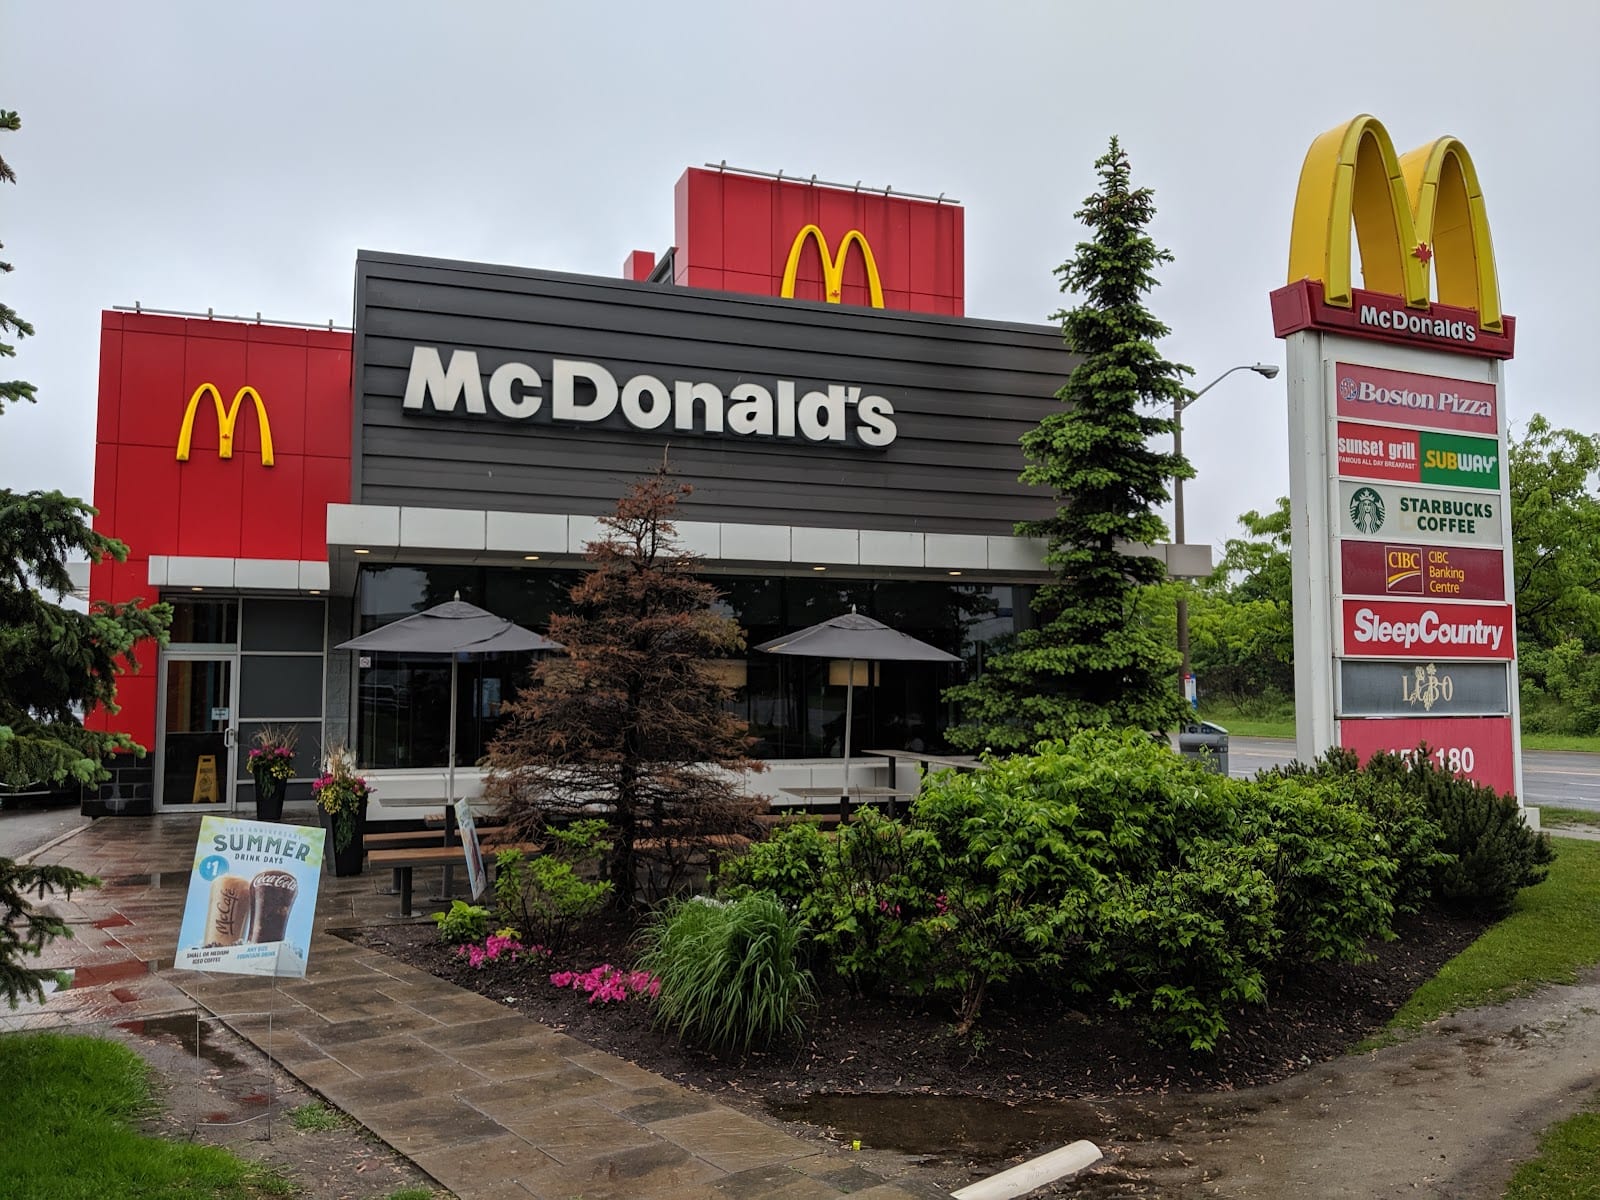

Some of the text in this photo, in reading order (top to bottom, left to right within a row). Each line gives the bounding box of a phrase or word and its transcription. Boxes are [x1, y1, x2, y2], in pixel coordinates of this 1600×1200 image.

[1360, 304, 1477, 342] McDonald's
[403, 346, 898, 447] McDonald's
[1359, 381, 1493, 417] Boston Pizza
[1338, 437, 1417, 460] sunset grill
[1338, 456, 1416, 470] FAMOUS ALL DAY BREAKFAST
[1424, 450, 1497, 474] SUBWAY
[1400, 497, 1493, 518] STARBUCKS
[1417, 516, 1476, 534] COFFEE
[1388, 551, 1420, 569] CIBC
[1428, 551, 1449, 564] CIBC
[1429, 567, 1465, 583] Banking
[1429, 580, 1460, 594] Centre
[1354, 608, 1504, 650] SleepCountry
[213, 834, 311, 862] SUMMER
[234, 853, 283, 865] DRINK DAYS
[253, 872, 297, 892] Coca-Cola
